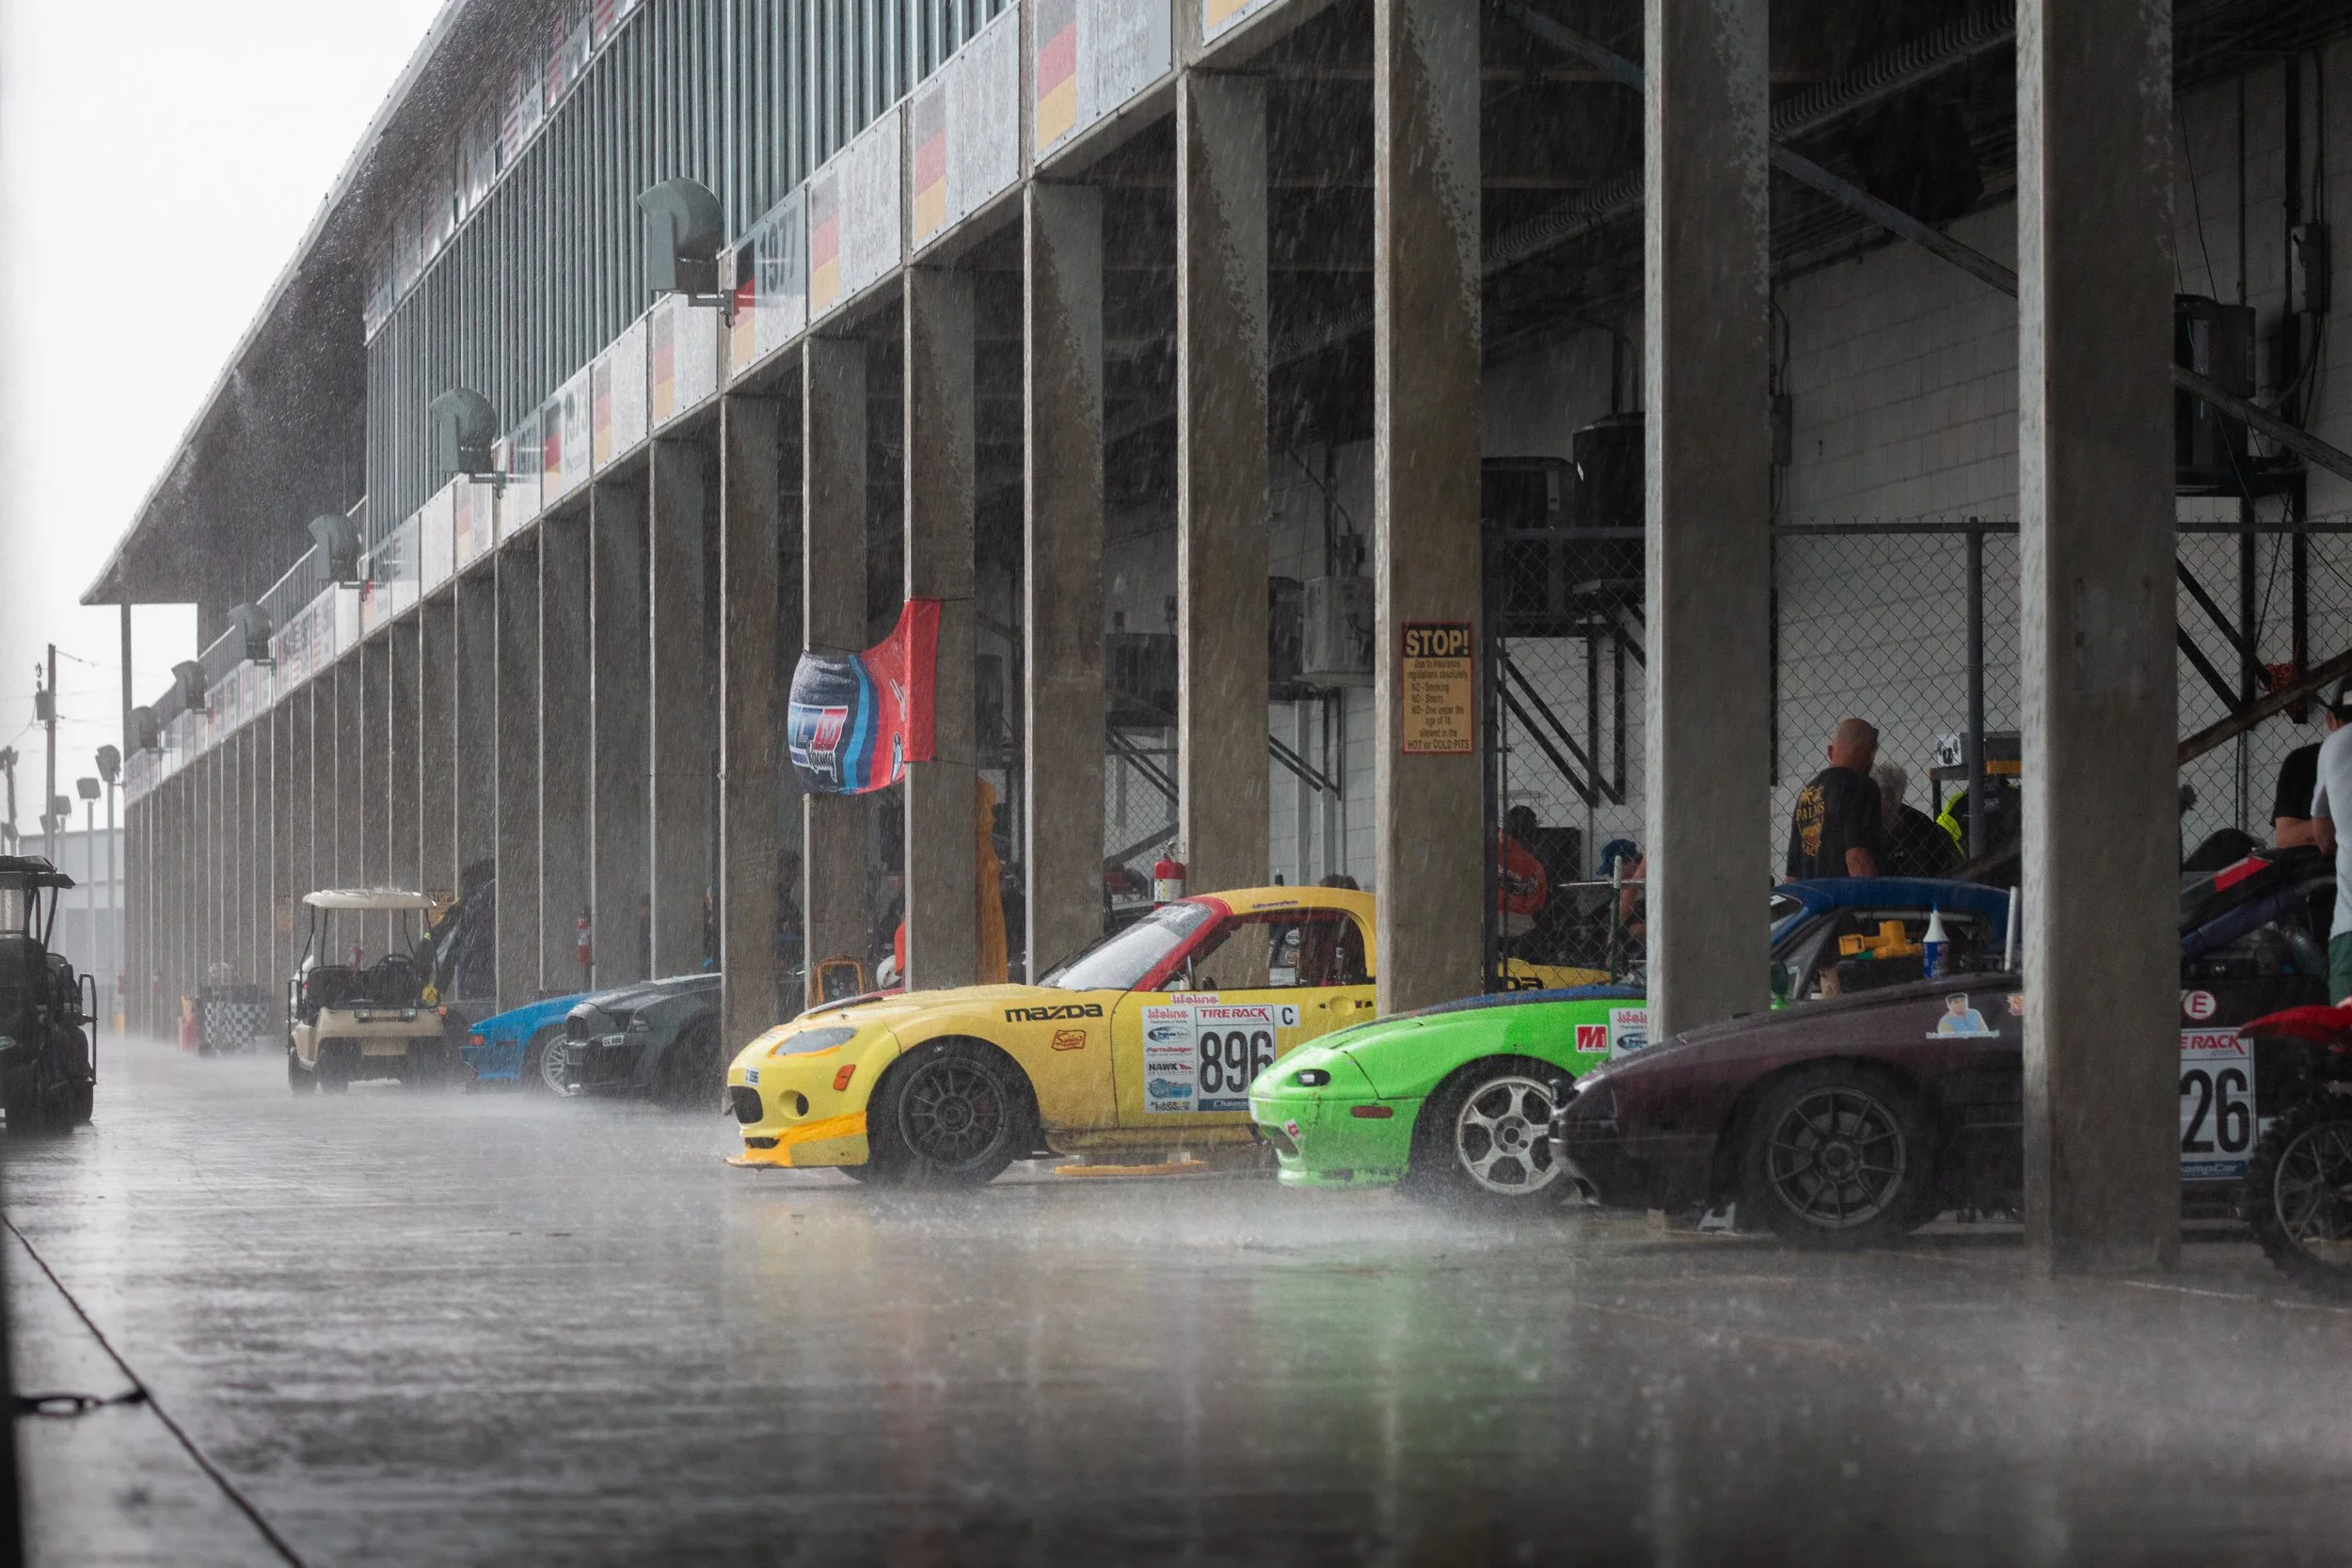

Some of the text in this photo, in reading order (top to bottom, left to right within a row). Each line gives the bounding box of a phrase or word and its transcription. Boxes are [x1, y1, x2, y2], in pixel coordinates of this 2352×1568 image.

[760, 207, 798, 296] 1977
[1406, 629, 1469, 656] STOP!
[1407, 739, 1422, 750] HOT
[1454, 738, 1469, 750] PITS
[2191, 994, 2207, 1013] E
[1200, 1008, 1231, 1019] TIRE
[1232, 1008, 1270, 1022] RACK
[1281, 1007, 1294, 1025] C
[2190, 1035, 2246, 1054] RACK
[1200, 1030, 1273, 1093] 896
[2180, 1068, 2249, 1153] 26
